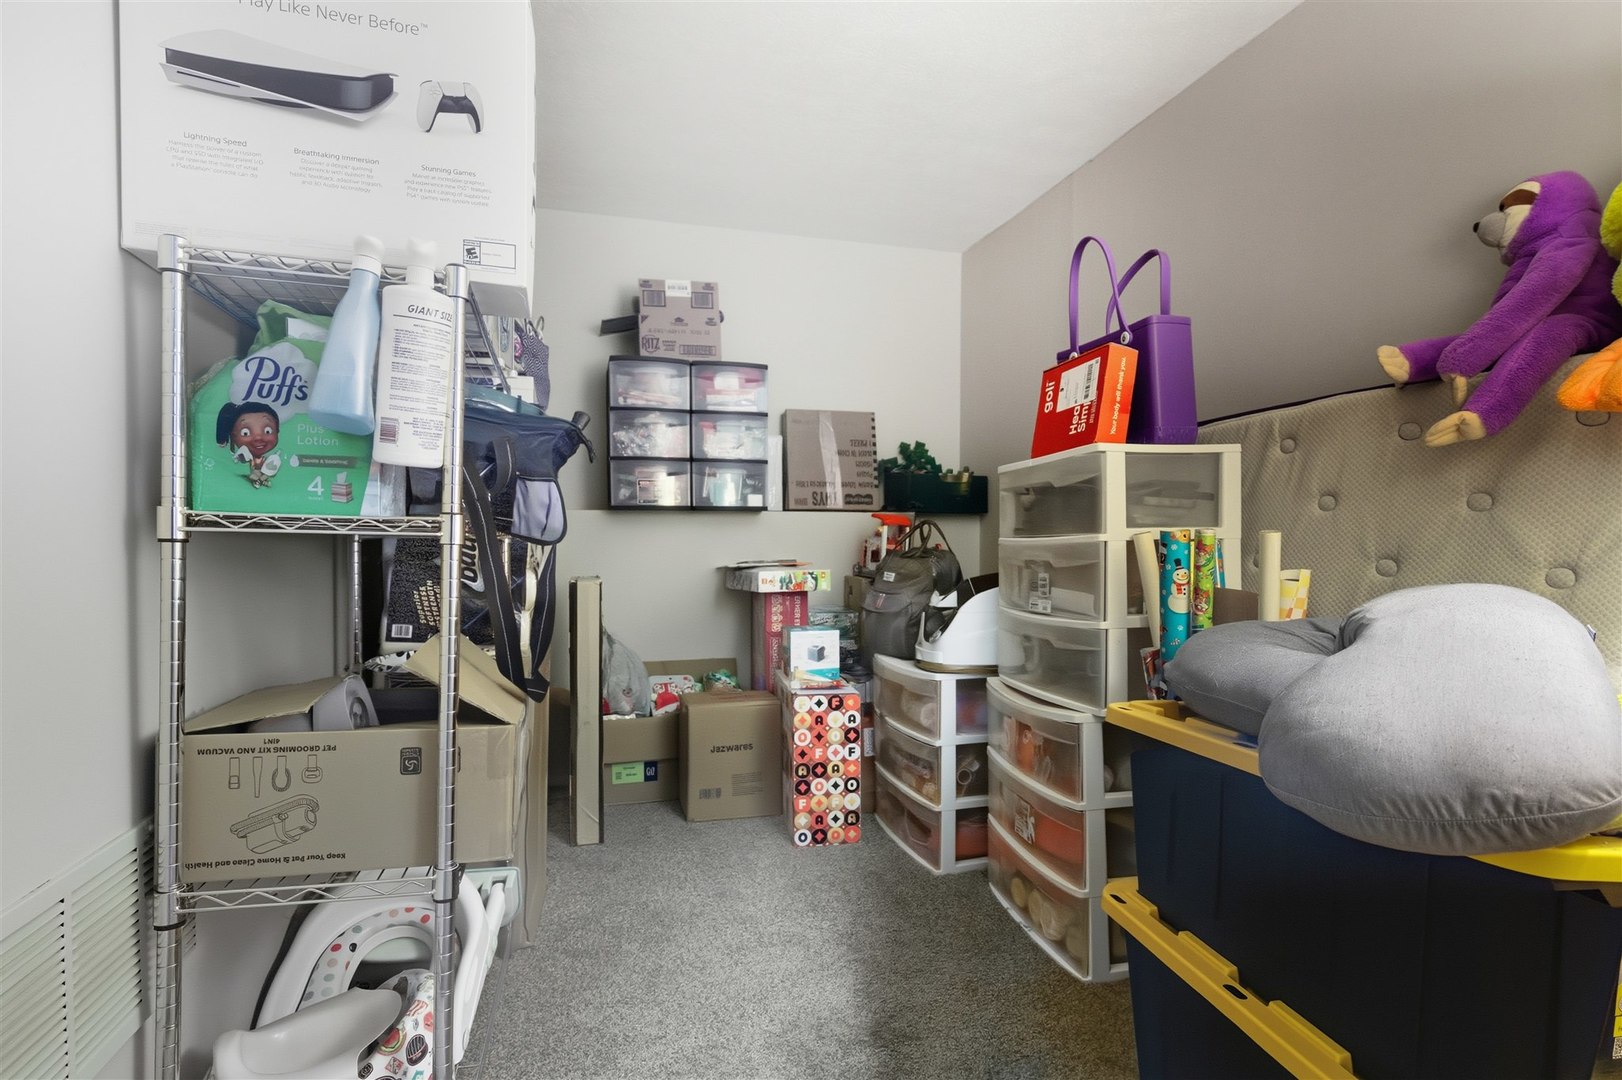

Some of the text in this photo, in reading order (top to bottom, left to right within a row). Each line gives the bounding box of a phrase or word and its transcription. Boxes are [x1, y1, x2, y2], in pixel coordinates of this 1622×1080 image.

[279, 0, 310, 16] Like
[316, 4, 363, 25] Never
[183, 132, 247, 148] Lightning Speed
[294, 147, 380, 165] Breathtaking Immersion
[421, 164, 476, 177] Stunning Games
[408, 304, 439, 318] GIANT
[642, 336, 660, 350] RITZ
[242, 357, 308, 406] Puffs
[1044, 380, 1055, 413] goli
[1112, 402, 1121, 416] body
[298, 424, 324, 434] Plus
[297, 436, 338, 446] Lotion
[307, 475, 324, 495] 4
[832, 697, 840, 708] F
[815, 714, 856, 725] A A
[710, 744, 753, 753] Jazwares
[815, 747, 856, 758] F F
[798, 764, 840, 776] A A
[799, 799, 806, 809] F
[816, 814, 856, 825] A A
